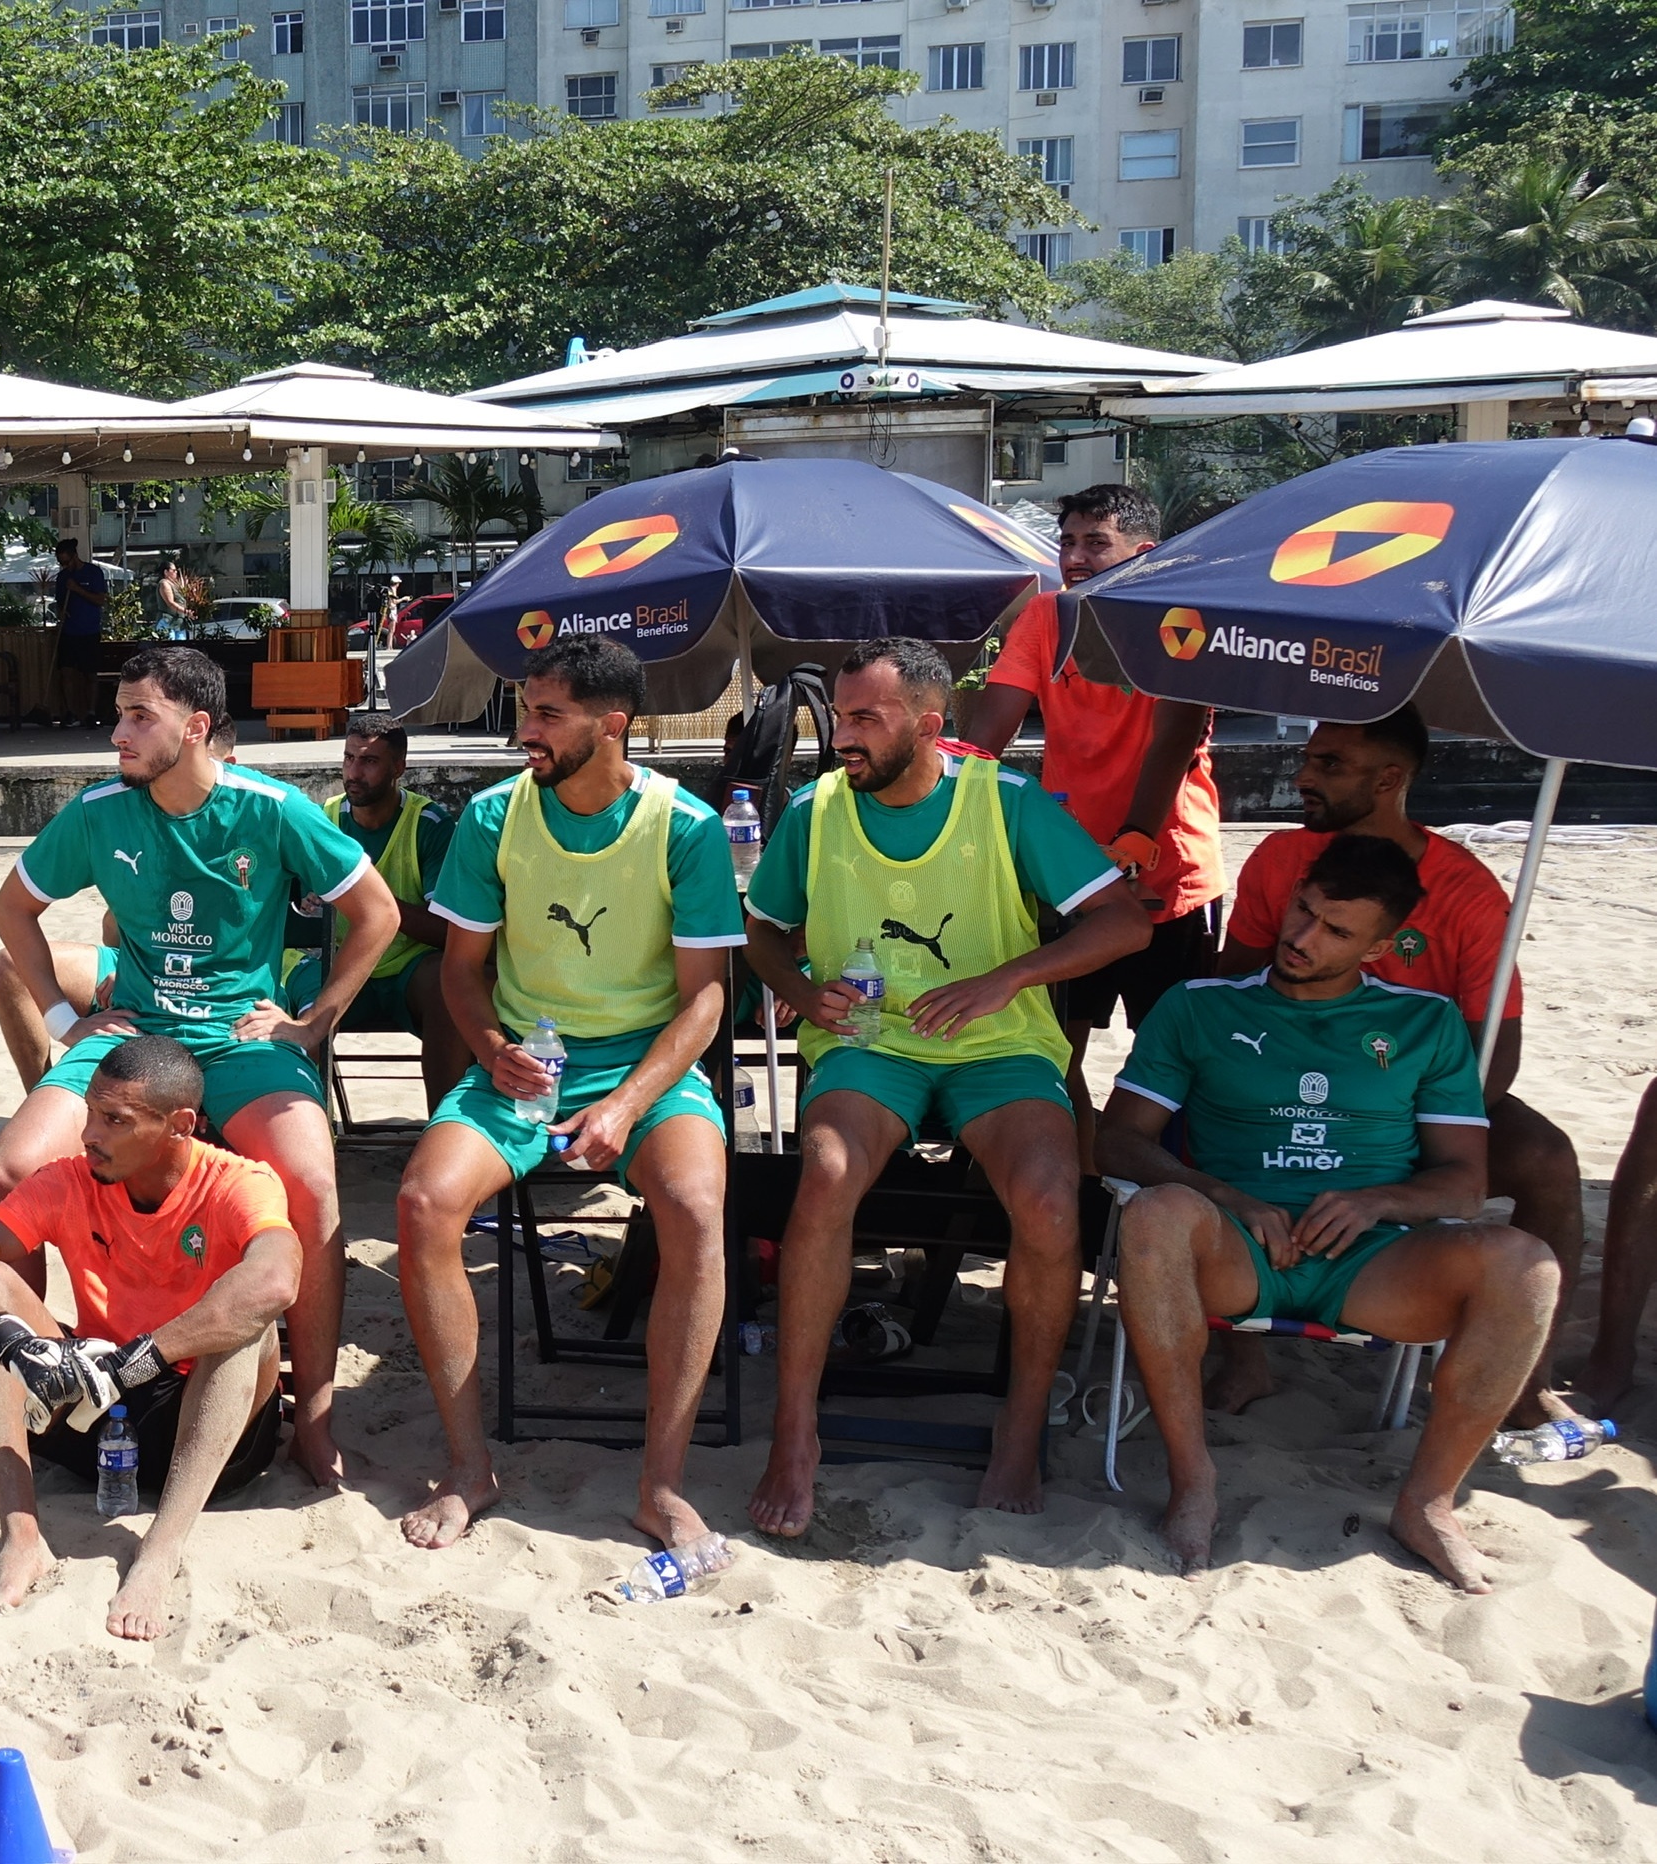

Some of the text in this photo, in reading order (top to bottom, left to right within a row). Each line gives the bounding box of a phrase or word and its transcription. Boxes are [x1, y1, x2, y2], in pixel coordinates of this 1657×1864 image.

[557, 598, 689, 637] Aliance Brasil
[636, 623, 689, 638] Benefícios
[1208, 625, 1384, 677] Aliance Brasil
[1309, 669, 1380, 693] Benefícios
[167, 922, 194, 934] VISIT
[151, 931, 213, 946] MOROCCO
[159, 980, 210, 991] MOROCCO
[1269, 1107, 1350, 1118] MORO
